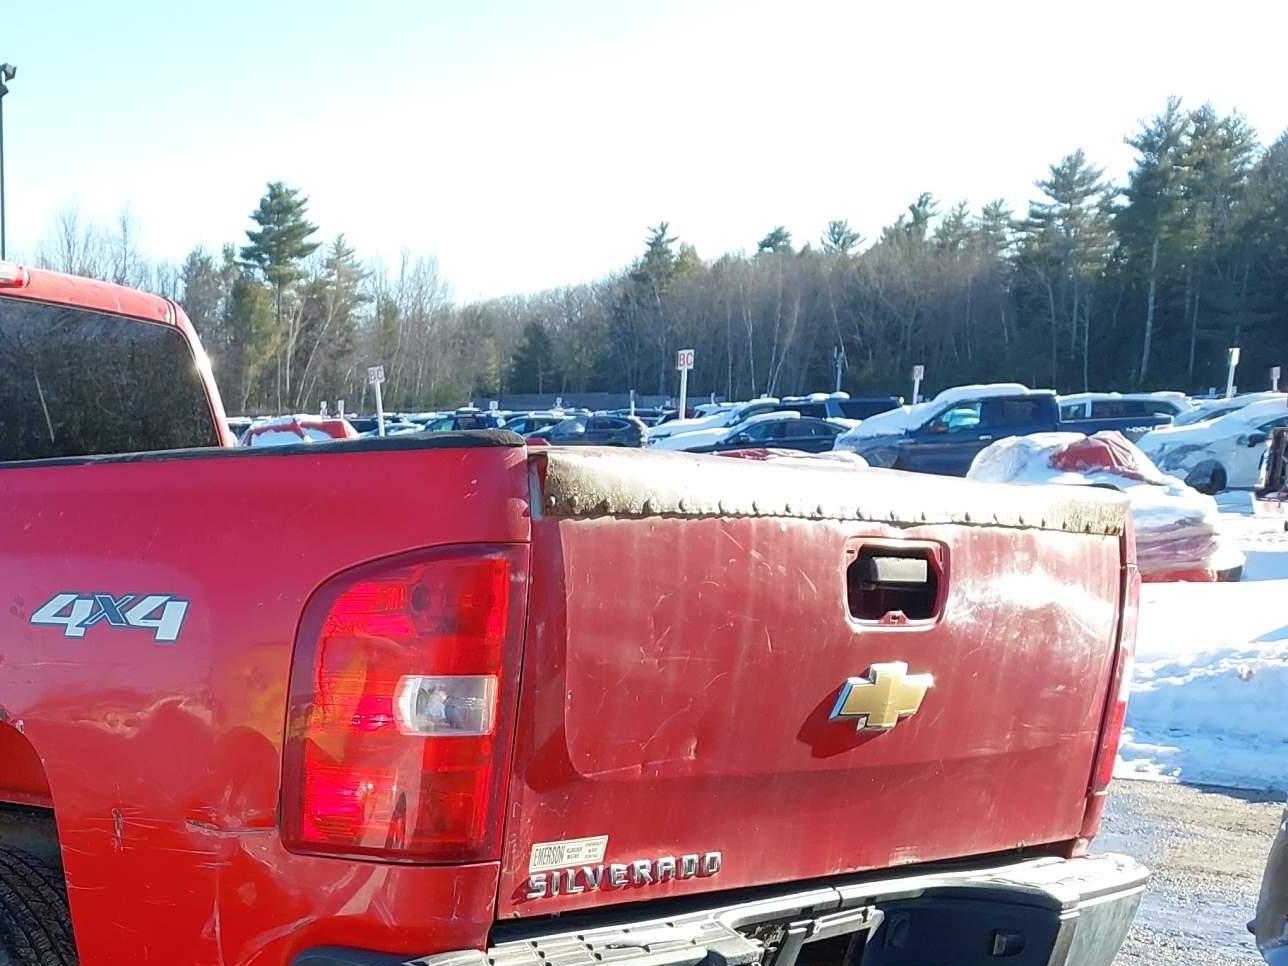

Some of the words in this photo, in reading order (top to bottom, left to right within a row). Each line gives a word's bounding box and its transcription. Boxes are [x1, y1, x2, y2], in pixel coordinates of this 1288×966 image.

[679, 352, 693, 367] BC
[533, 845, 566, 867] EMERSON
[526, 851, 722, 900] SILVERADO
